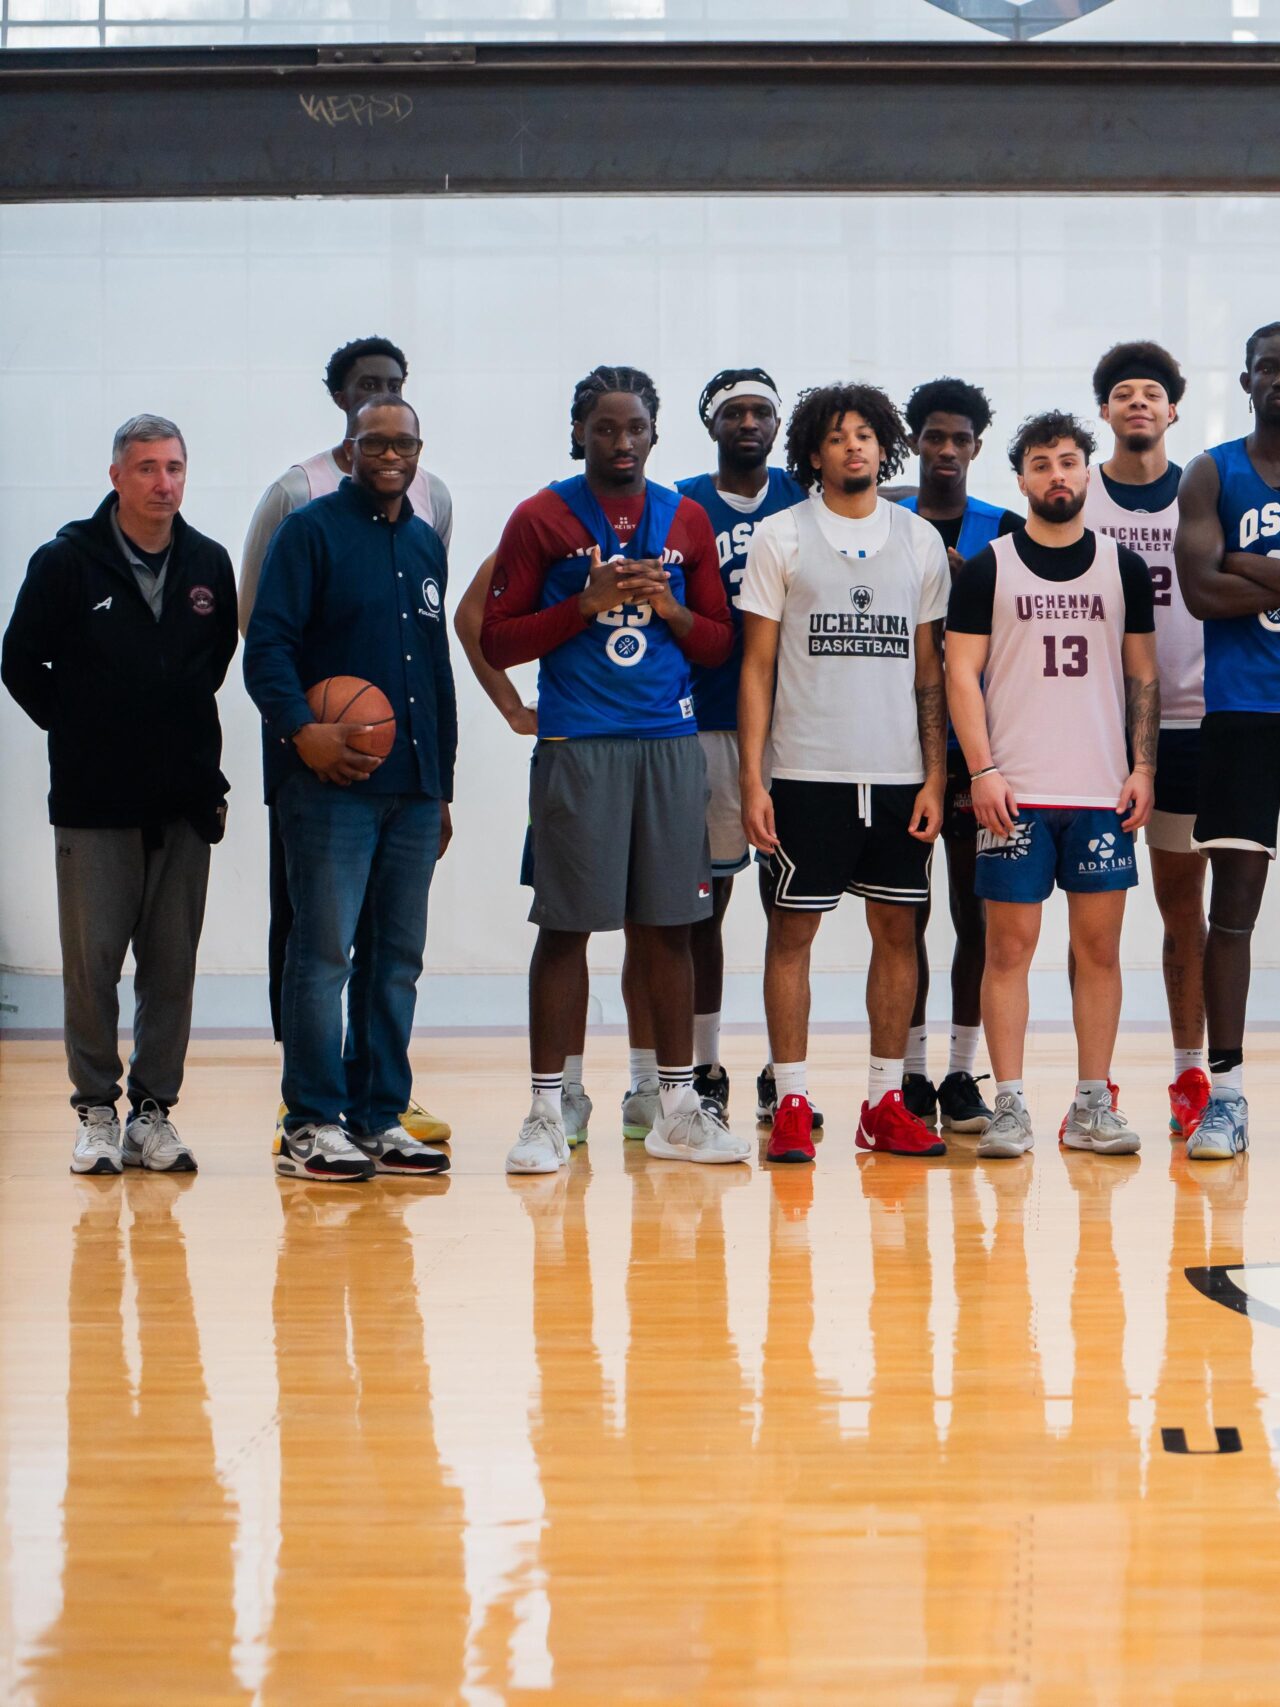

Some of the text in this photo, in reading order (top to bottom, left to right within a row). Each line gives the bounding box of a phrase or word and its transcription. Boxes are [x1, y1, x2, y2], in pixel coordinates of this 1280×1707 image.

[1101, 526, 1176, 543] CHENN
[716, 522, 761, 569] QS
[1015, 594, 1106, 622] UCHENNA
[1036, 610, 1088, 619] SELECT
[809, 614, 909, 636] UCHENNA
[811, 639, 908, 655] BASKETBALL
[1043, 635, 1088, 677] 13
[1078, 857, 1133, 871] ADKINS
